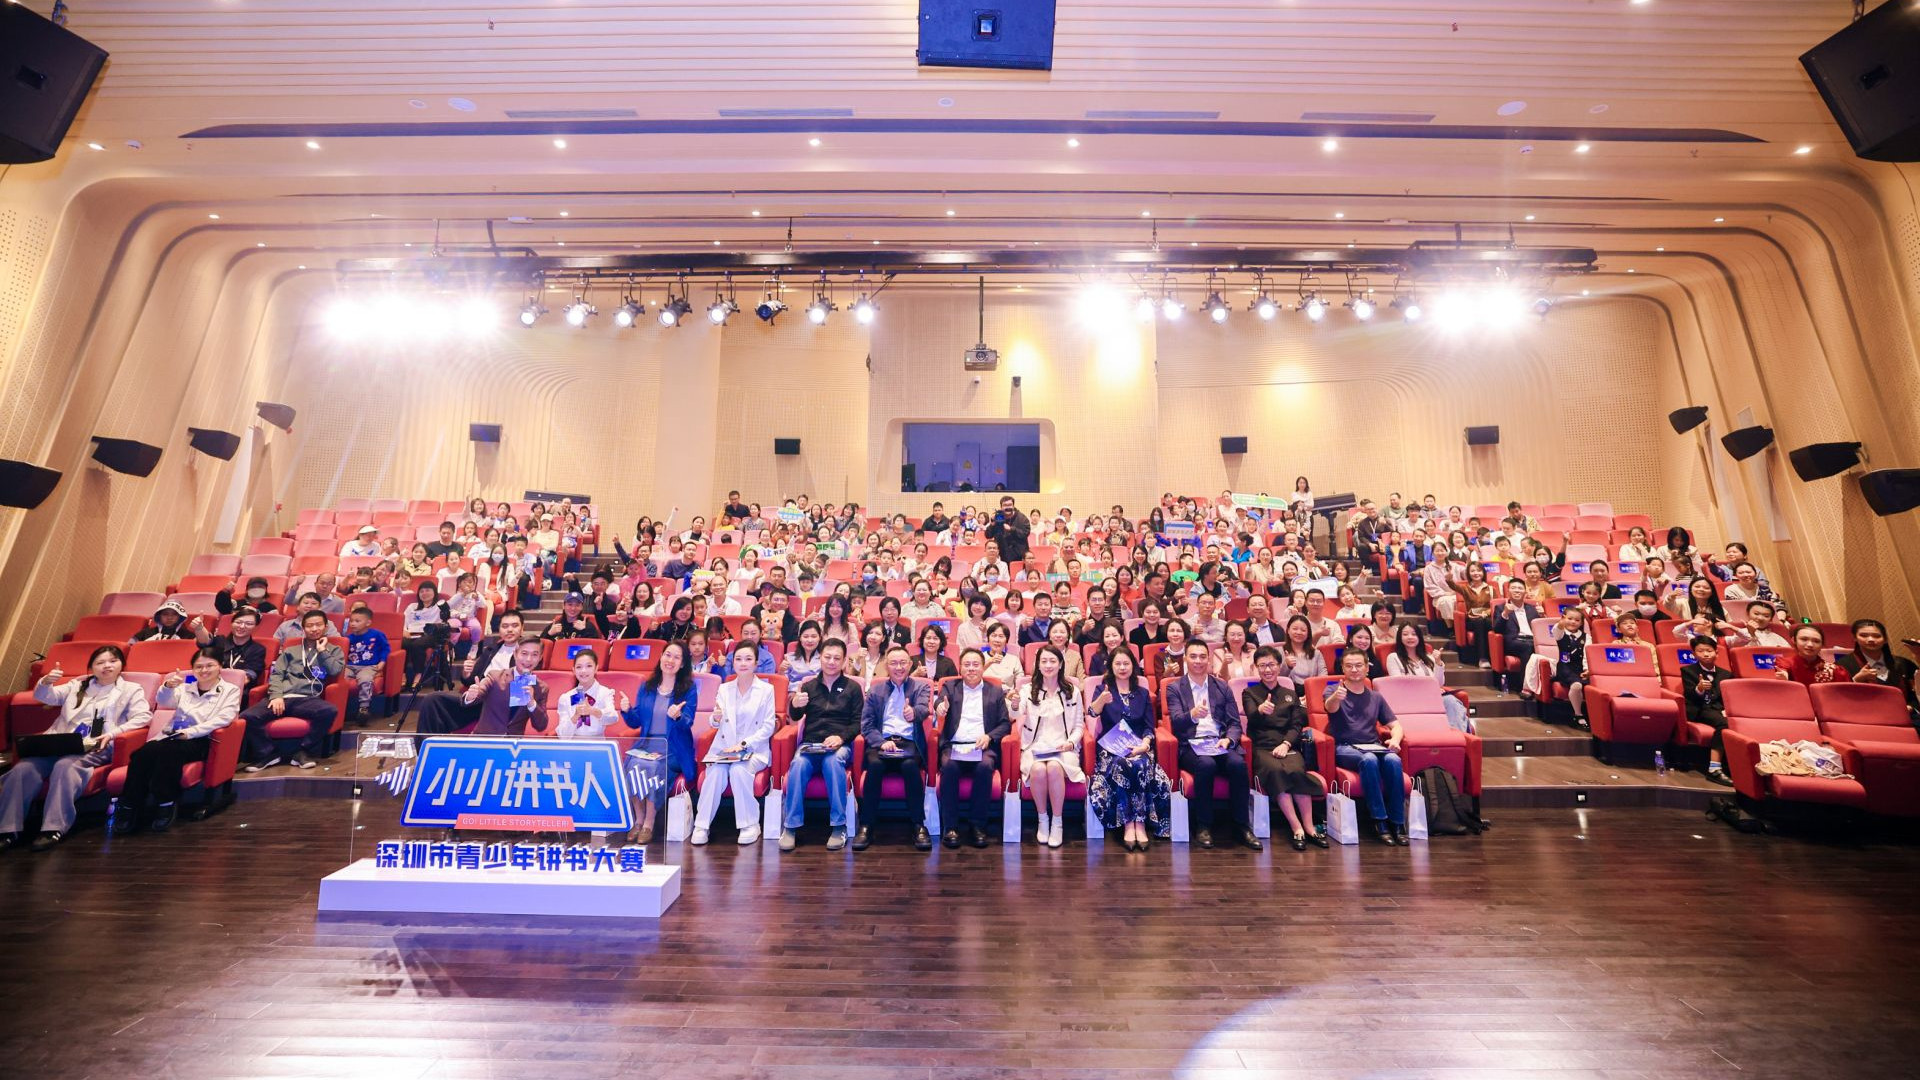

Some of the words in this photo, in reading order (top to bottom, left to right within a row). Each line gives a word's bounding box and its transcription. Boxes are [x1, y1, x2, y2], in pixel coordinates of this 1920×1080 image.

[358, 736, 415, 758] 第二届
[425, 758, 611, 809] 小小讲书人
[479, 818, 508, 826] LITTLE
[509, 819, 569, 828] STORYTELLER!
[376, 841, 645, 873] 深圳市青少年讲书大赛
